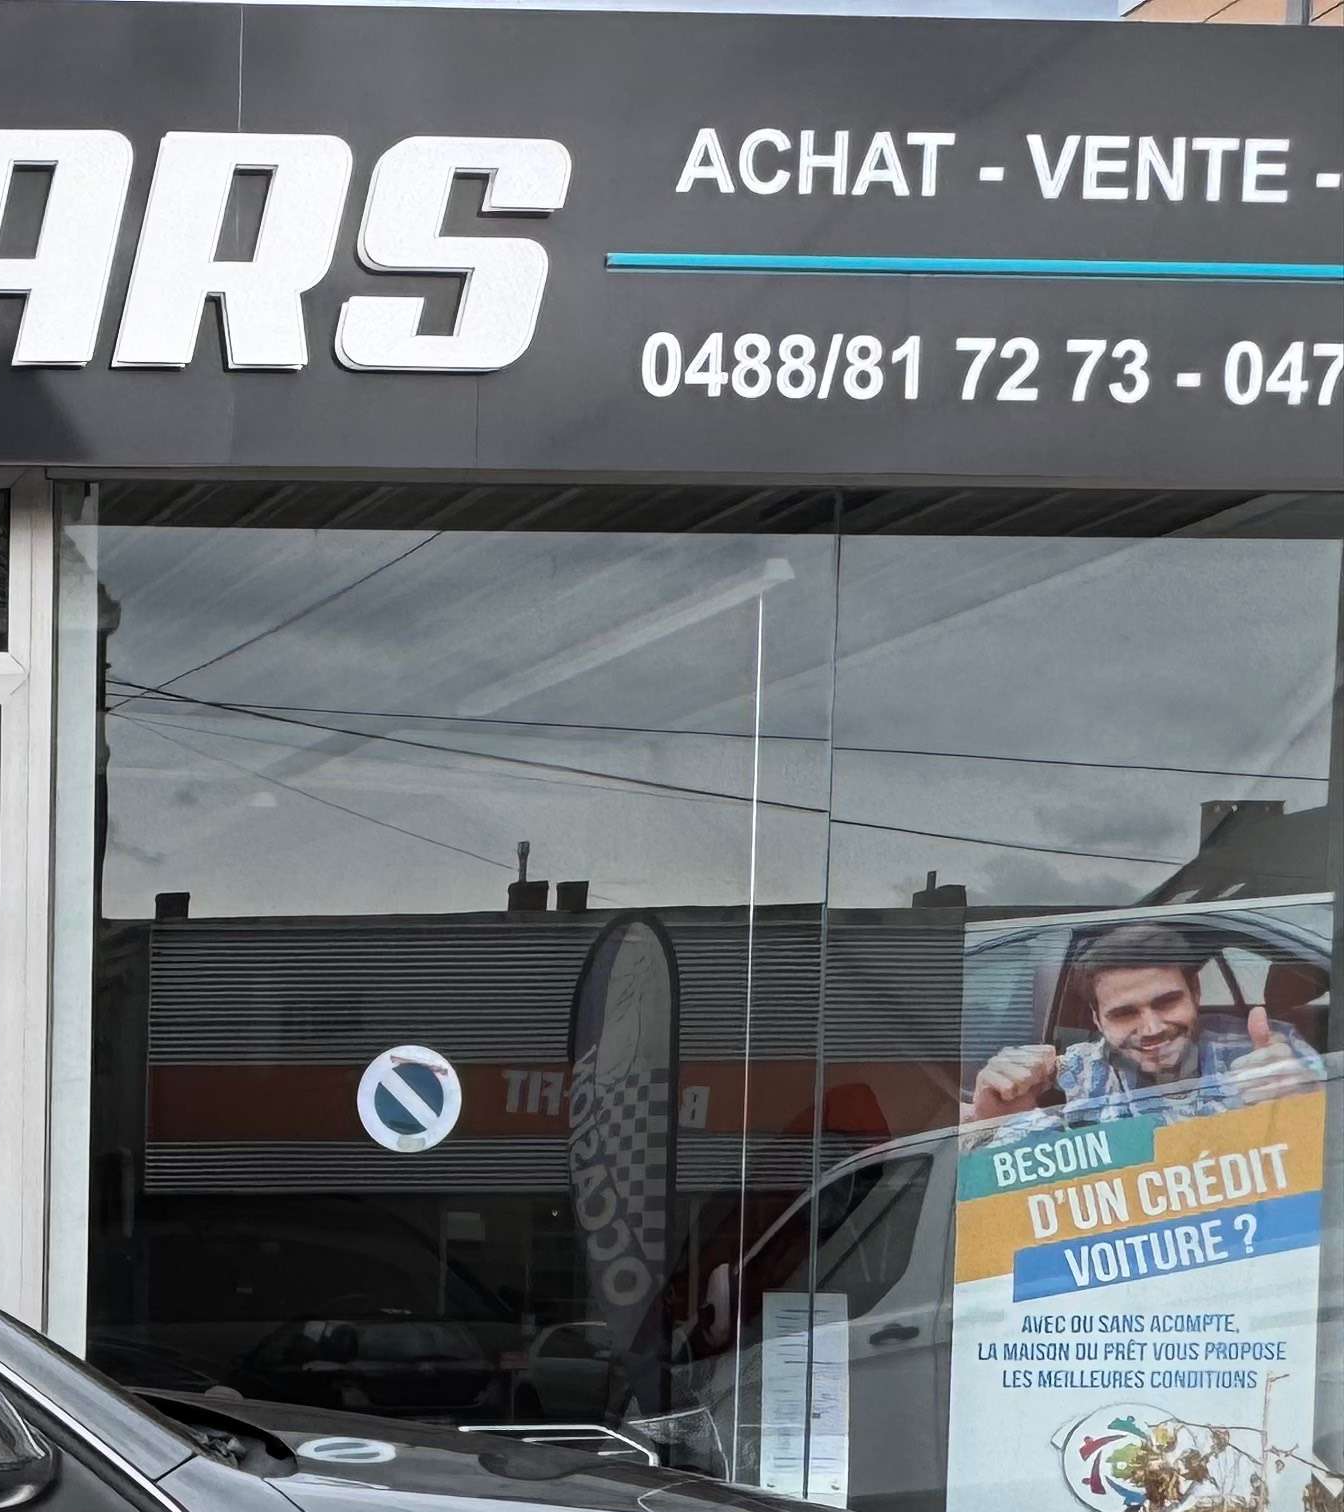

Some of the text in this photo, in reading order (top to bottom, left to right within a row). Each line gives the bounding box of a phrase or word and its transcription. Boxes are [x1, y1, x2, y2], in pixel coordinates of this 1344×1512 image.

[675, 128, 957, 198] ACHAT
[1026, 134, 1291, 204] VENTE
[641, 331, 922, 401] 0488/81
[955, 337, 1040, 402] 72
[1065, 338, 1151, 404] 73
[992, 1130, 1112, 1187] BESOIN
[1027, 1144, 1289, 1239] D'UN CRÉDIT
[1064, 1214, 1258, 1287] VOITURE ?
[977, 1337, 1287, 1361] LA MAISON DU PRÊT VOUS PROPOSE
[1021, 1314, 1240, 1334] AVEC OU SANS ACOMPTE,
[1002, 1370, 1258, 1389] LES MEILLEURES CONDITIONS
